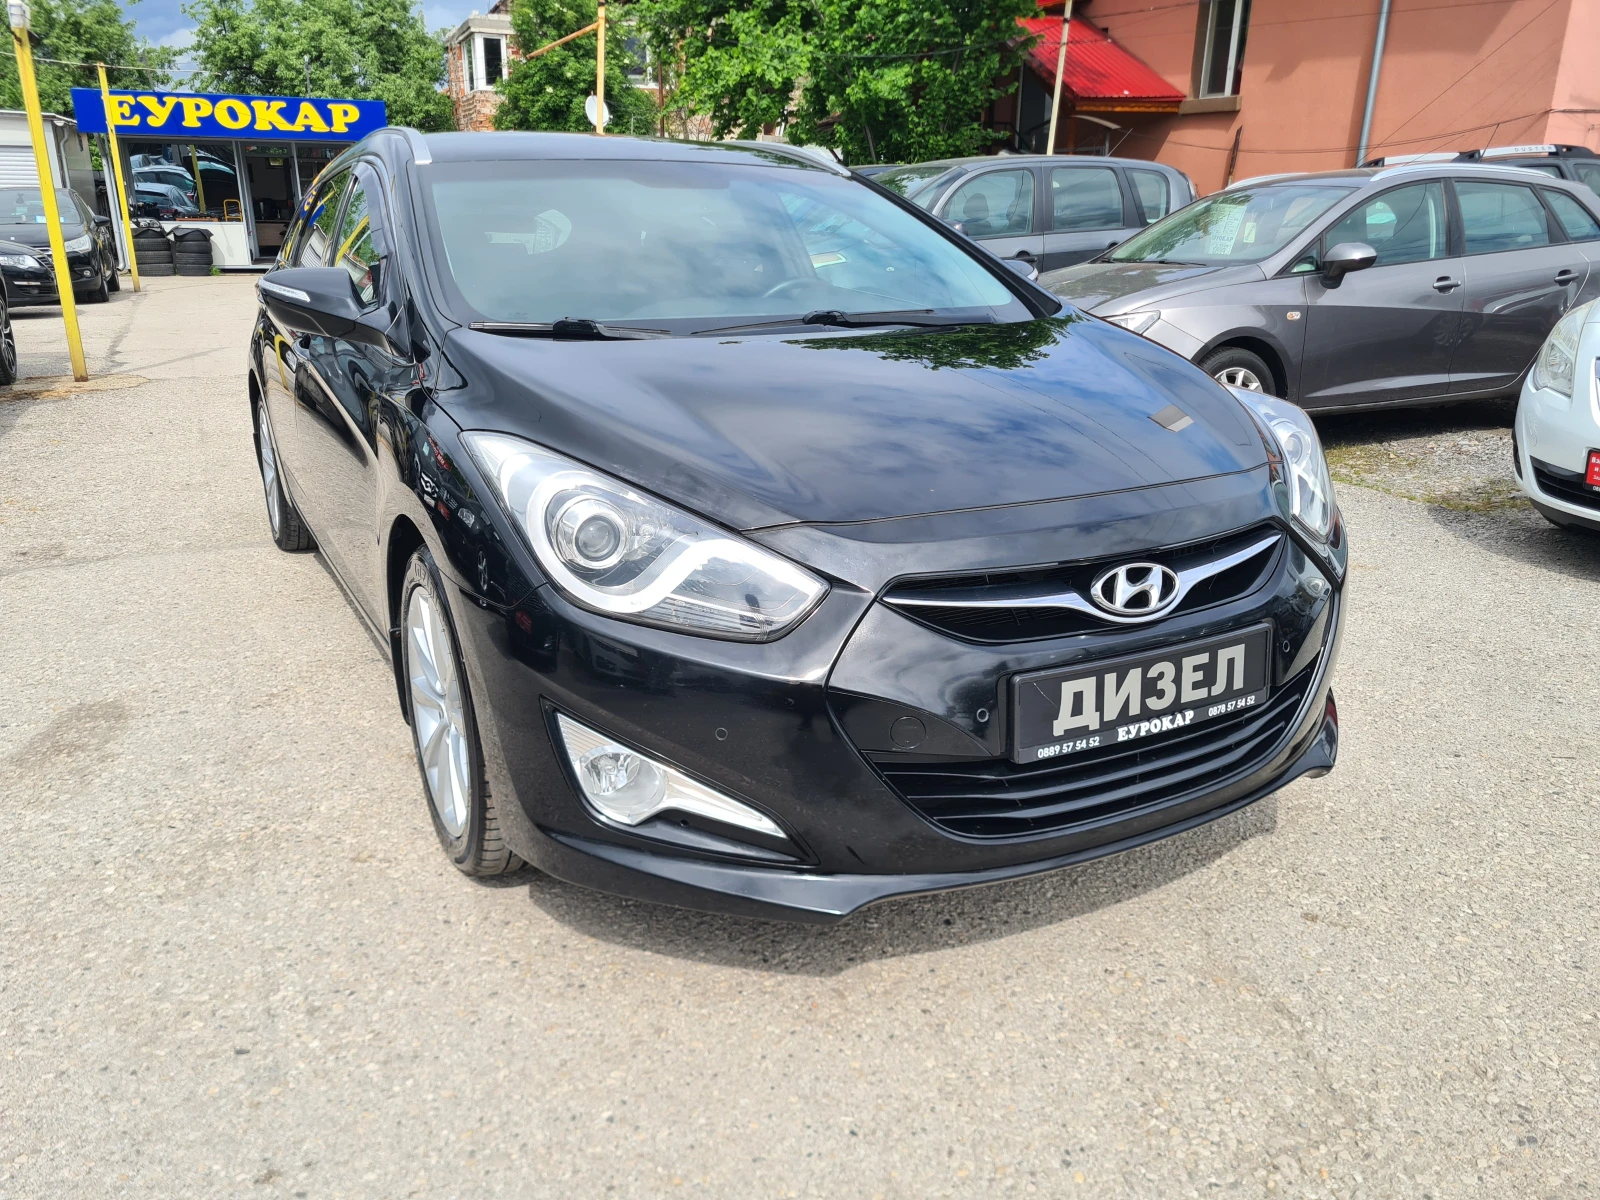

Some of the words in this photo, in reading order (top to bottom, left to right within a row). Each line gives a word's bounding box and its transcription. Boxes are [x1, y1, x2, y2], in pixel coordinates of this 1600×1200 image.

[103, 95, 360, 133] ЕУРОКАР
[1514, 145, 1553, 153] DUSTER
[1053, 643, 1245, 737] ДИЗЕЛ
[1208, 703, 1226, 717] 0878
[1226, 700, 1237, 711] 57
[1236, 697, 1246, 709] 54
[1246, 694, 1256, 706] 52
[1116, 709, 1195, 742] ЕУРОКАР
[1037, 744, 1061, 759] 0889
[1061, 741, 1074, 754] 57
[1075, 738, 1087, 751] 54
[1088, 736, 1100, 748] 52
